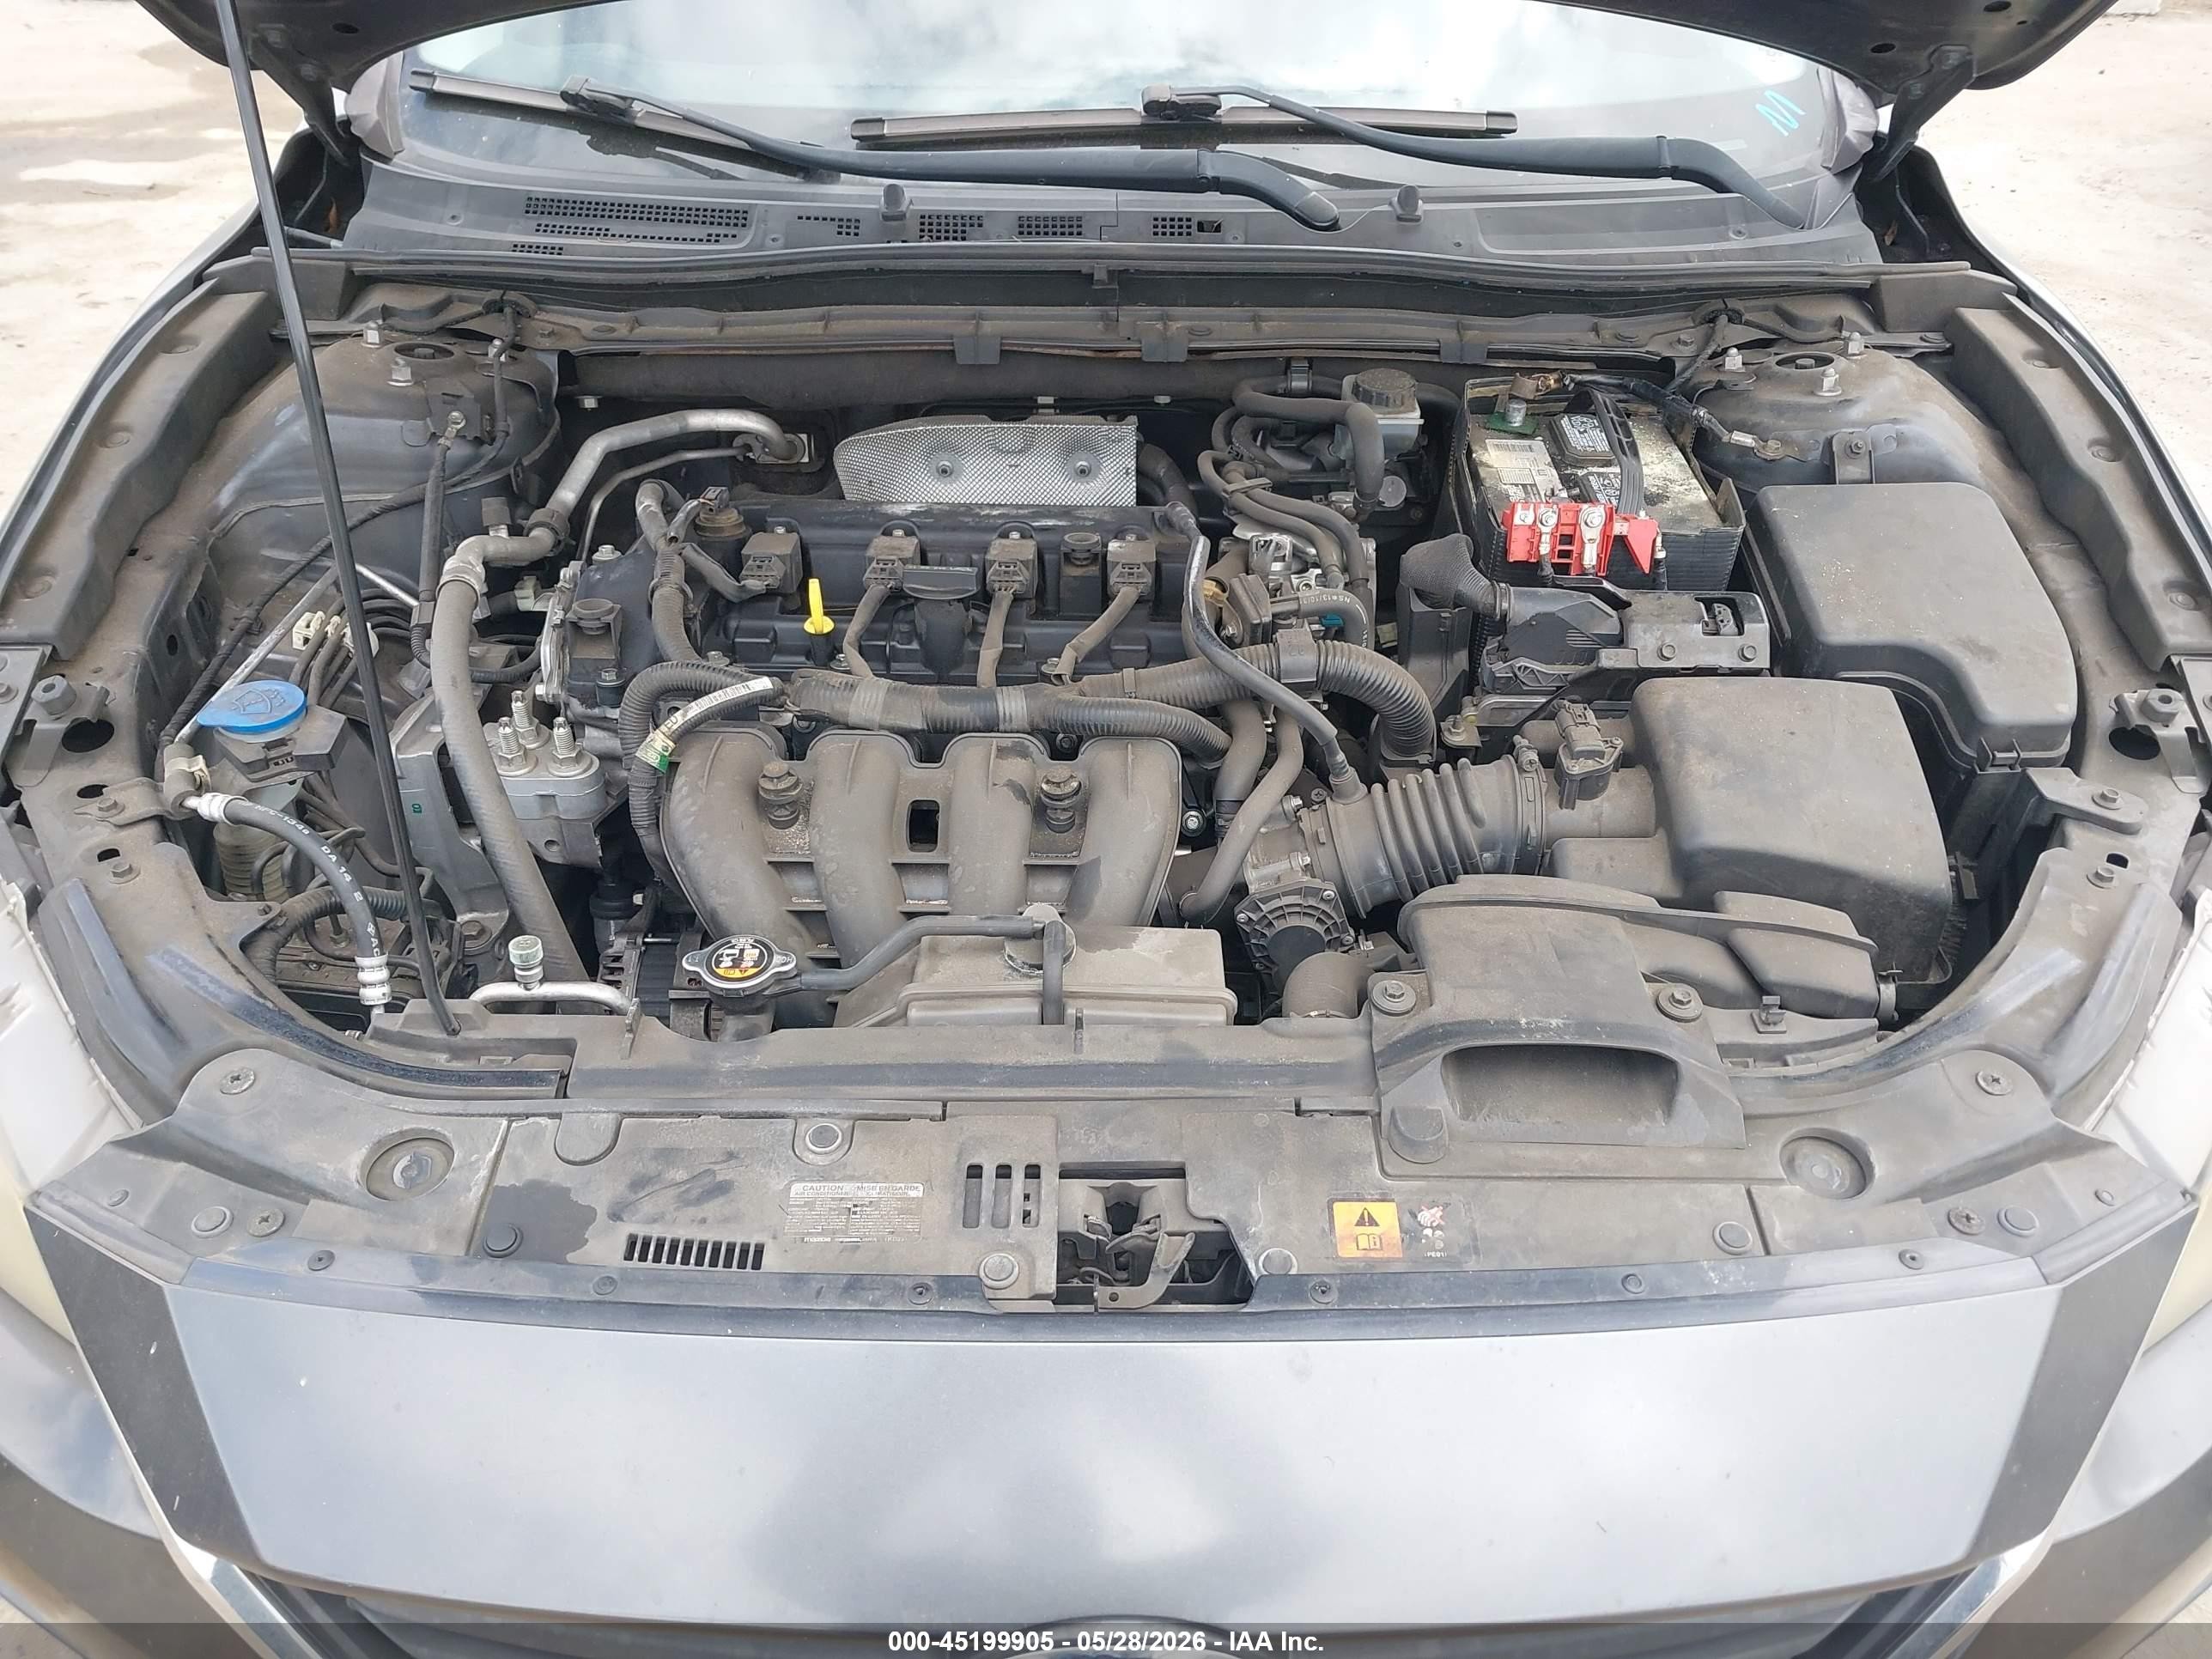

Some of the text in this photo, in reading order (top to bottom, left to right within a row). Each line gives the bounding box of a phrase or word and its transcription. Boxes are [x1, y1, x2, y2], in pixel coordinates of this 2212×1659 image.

[319, 845, 363, 902] DA 14 2
